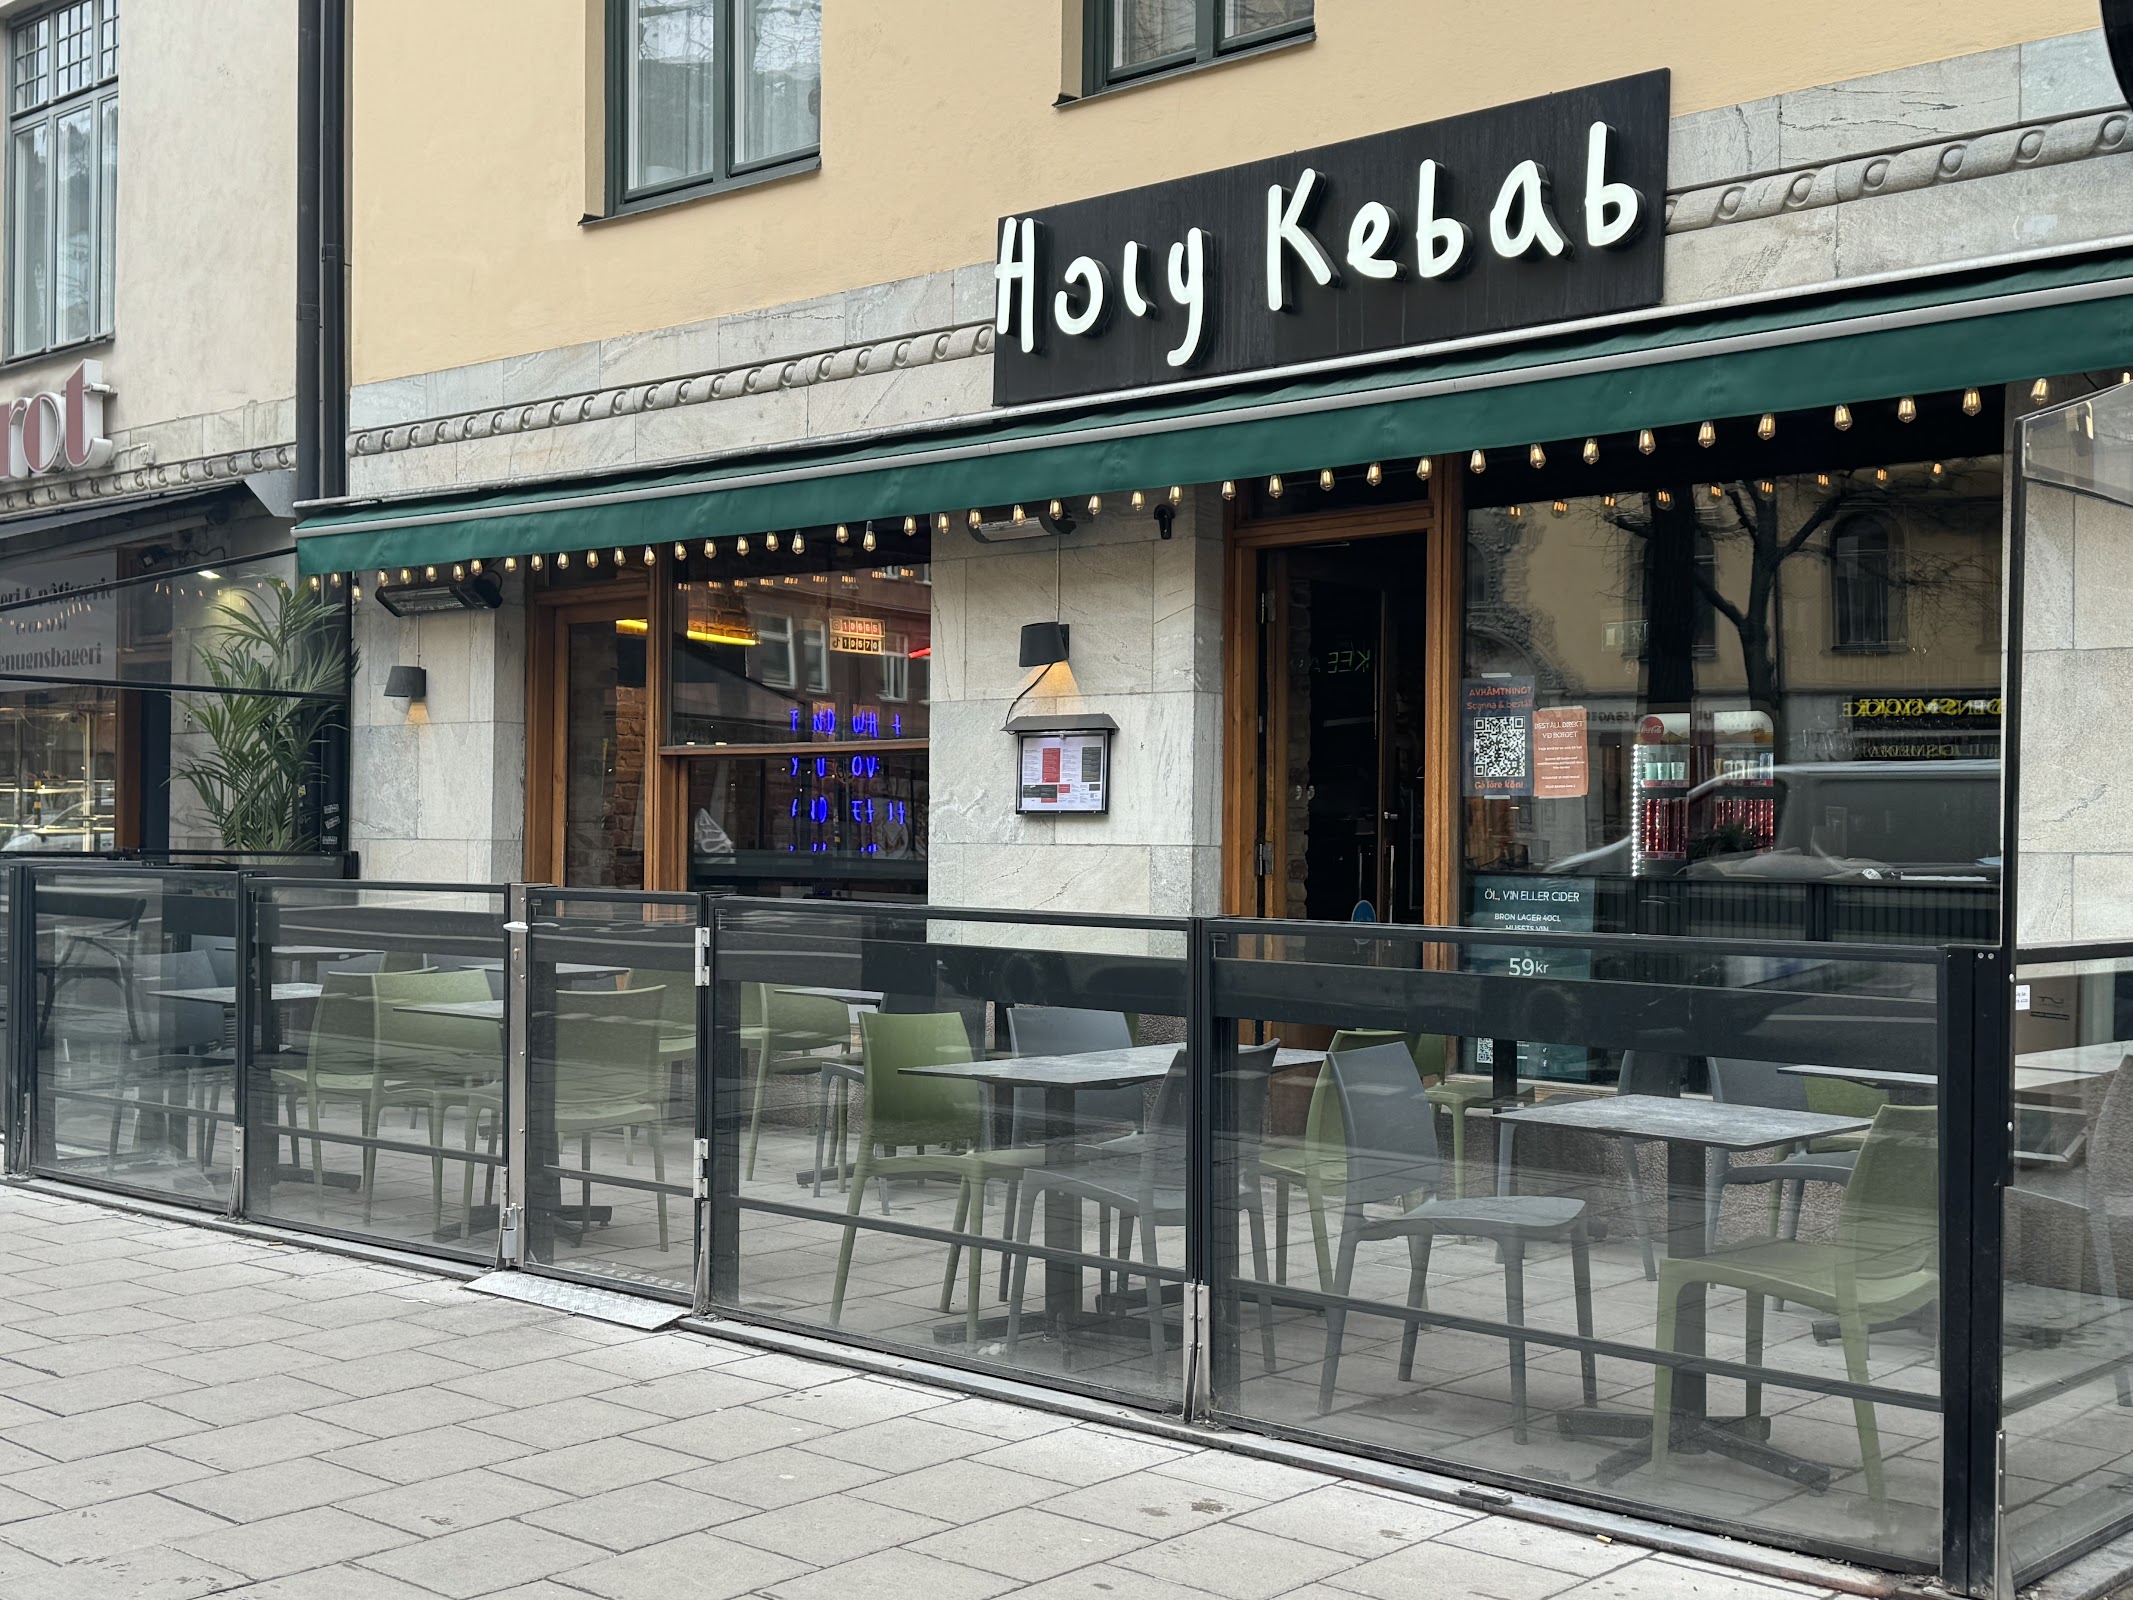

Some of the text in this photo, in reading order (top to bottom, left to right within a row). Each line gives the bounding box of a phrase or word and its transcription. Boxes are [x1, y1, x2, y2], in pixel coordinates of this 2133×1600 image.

[1267, 121, 1638, 311] Kebab
[1485, 888, 1580, 902] ÖL, VIN ELLER CIDER
[1517, 914, 1541, 922] LAGER
